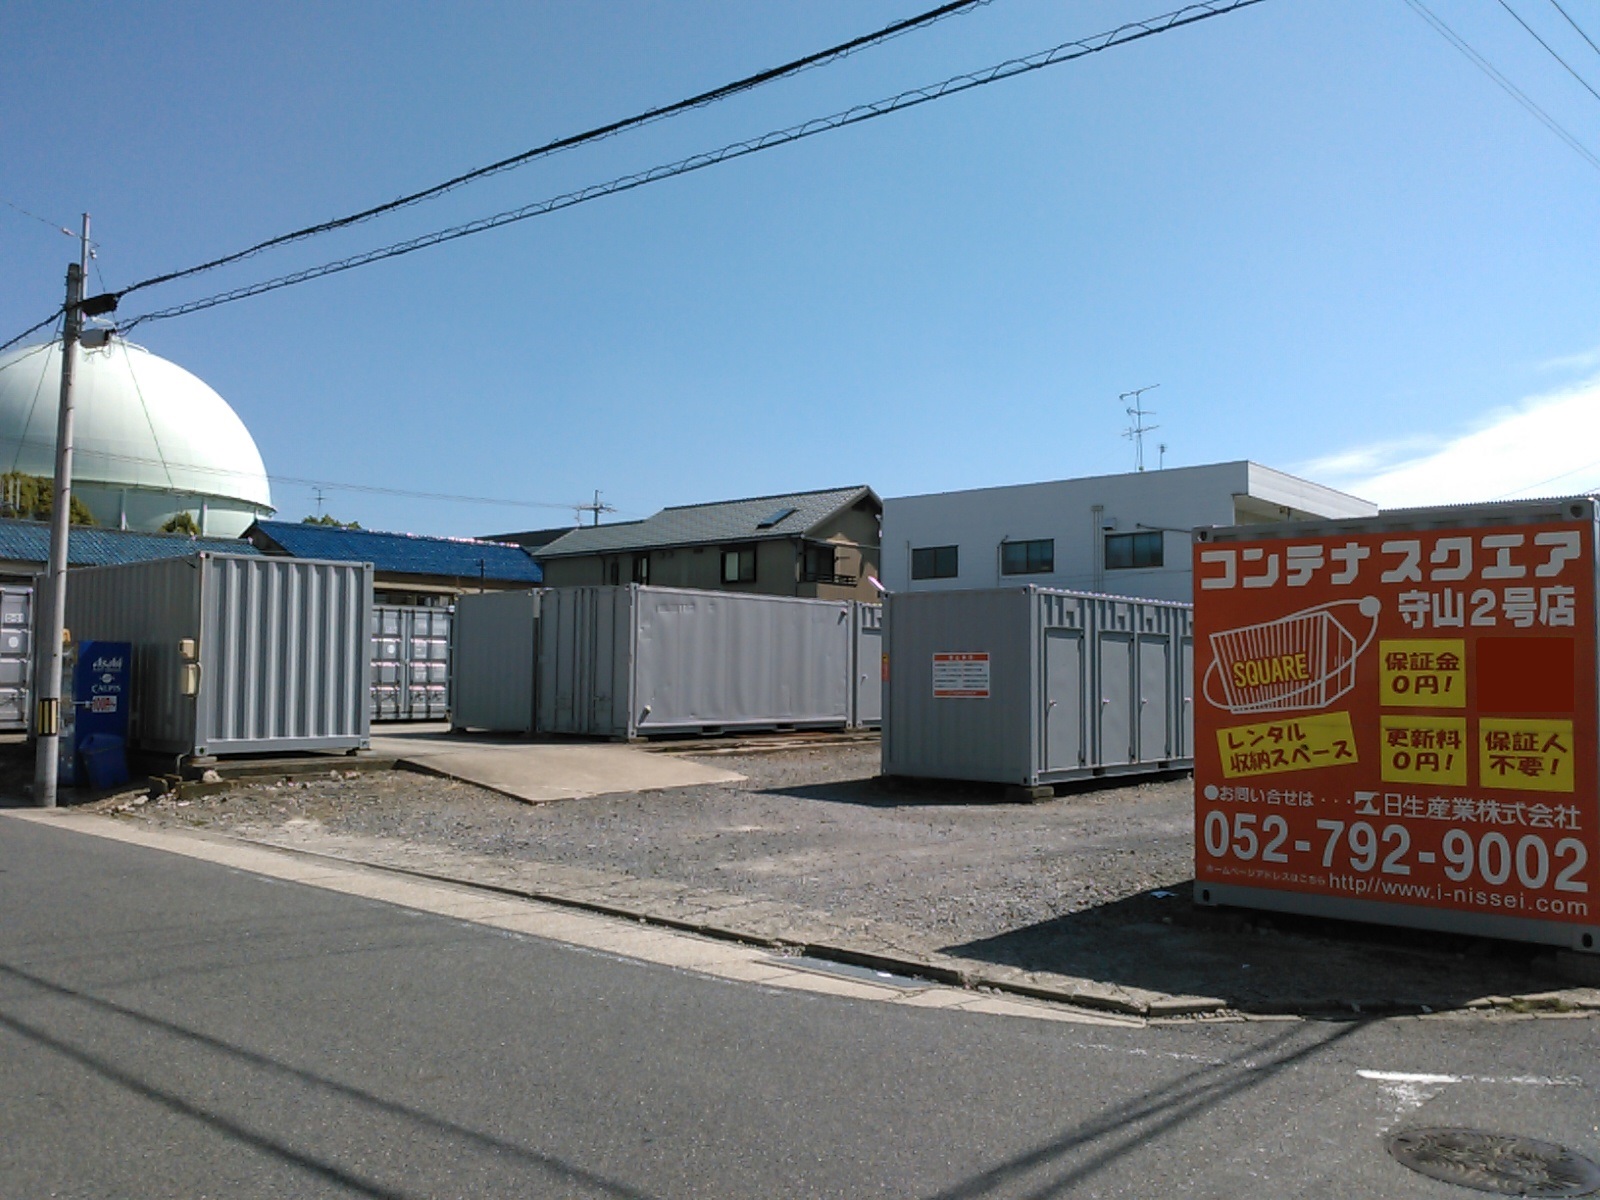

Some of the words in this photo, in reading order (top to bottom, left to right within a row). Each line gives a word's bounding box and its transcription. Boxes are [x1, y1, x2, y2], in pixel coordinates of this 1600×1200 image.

[1201, 530, 1581, 590] コンテナスクエア
[1398, 585, 1575, 629] 守山2号店
[1232, 652, 1310, 689] SQUARE
[1385, 651, 1460, 672] 保証金
[1228, 723, 1306, 750] レンタル
[1386, 728, 1462, 750] 更新料
[1485, 731, 1567, 753] 保証人
[1230, 739, 1352, 773] 収納スペース
[1384, 792, 1582, 830] 日生産業株式会社
[1204, 810, 1589, 893] 052-792-9002
[1329, 873, 1589, 916] http//www.i-nissei.com
